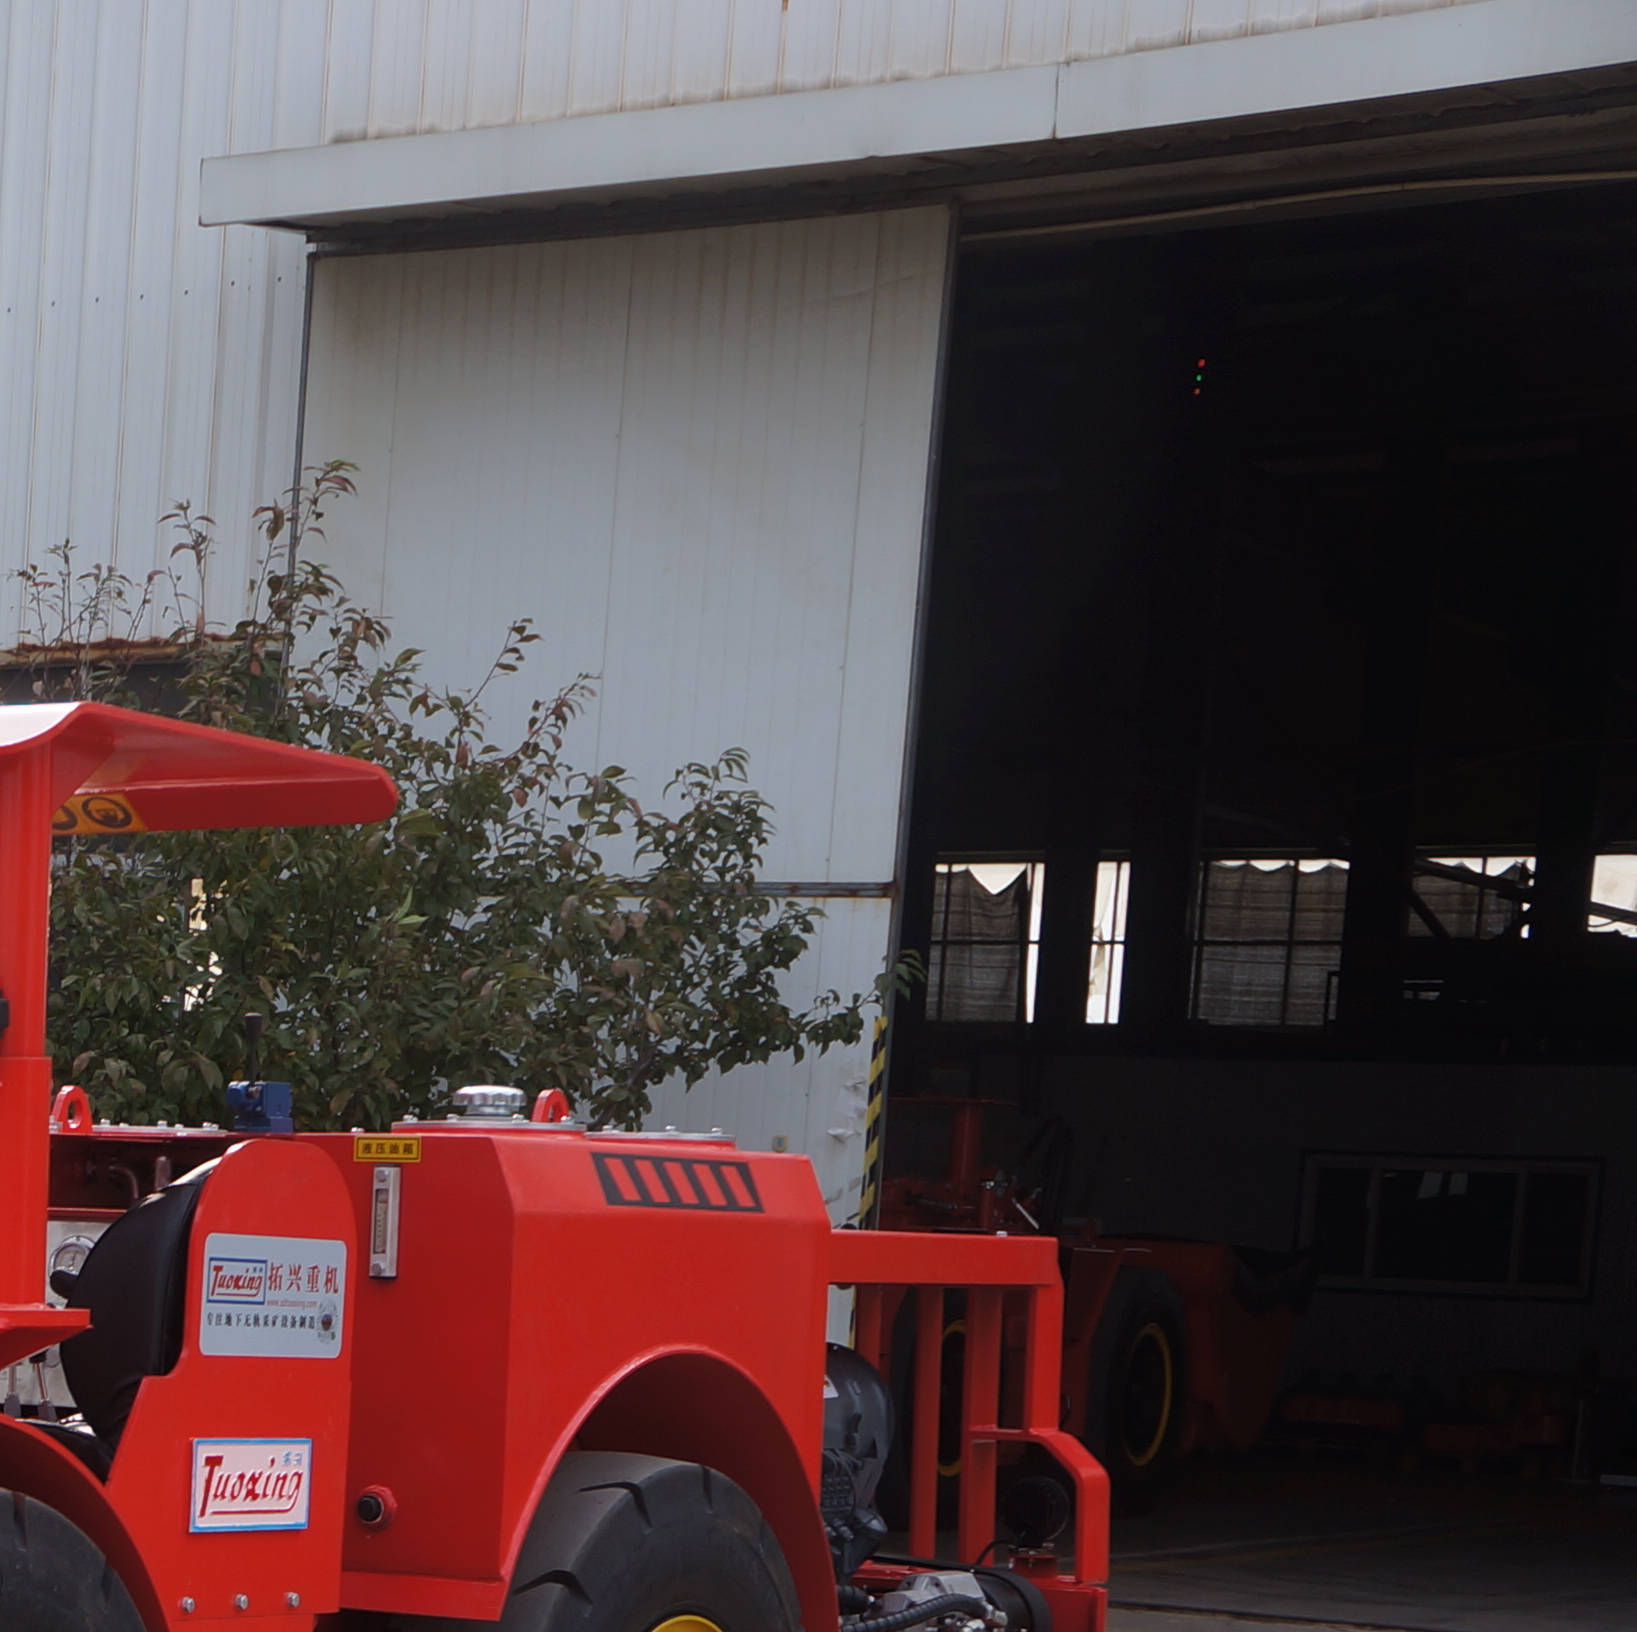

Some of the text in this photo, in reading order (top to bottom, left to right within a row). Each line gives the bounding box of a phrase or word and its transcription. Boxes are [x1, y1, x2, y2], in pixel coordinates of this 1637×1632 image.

[362, 1142, 413, 1155] 液压油箱
[210, 1265, 263, 1298] Tuoxing
[268, 1262, 339, 1294] 拓兴重机
[198, 1454, 303, 1518] Tuoxing
